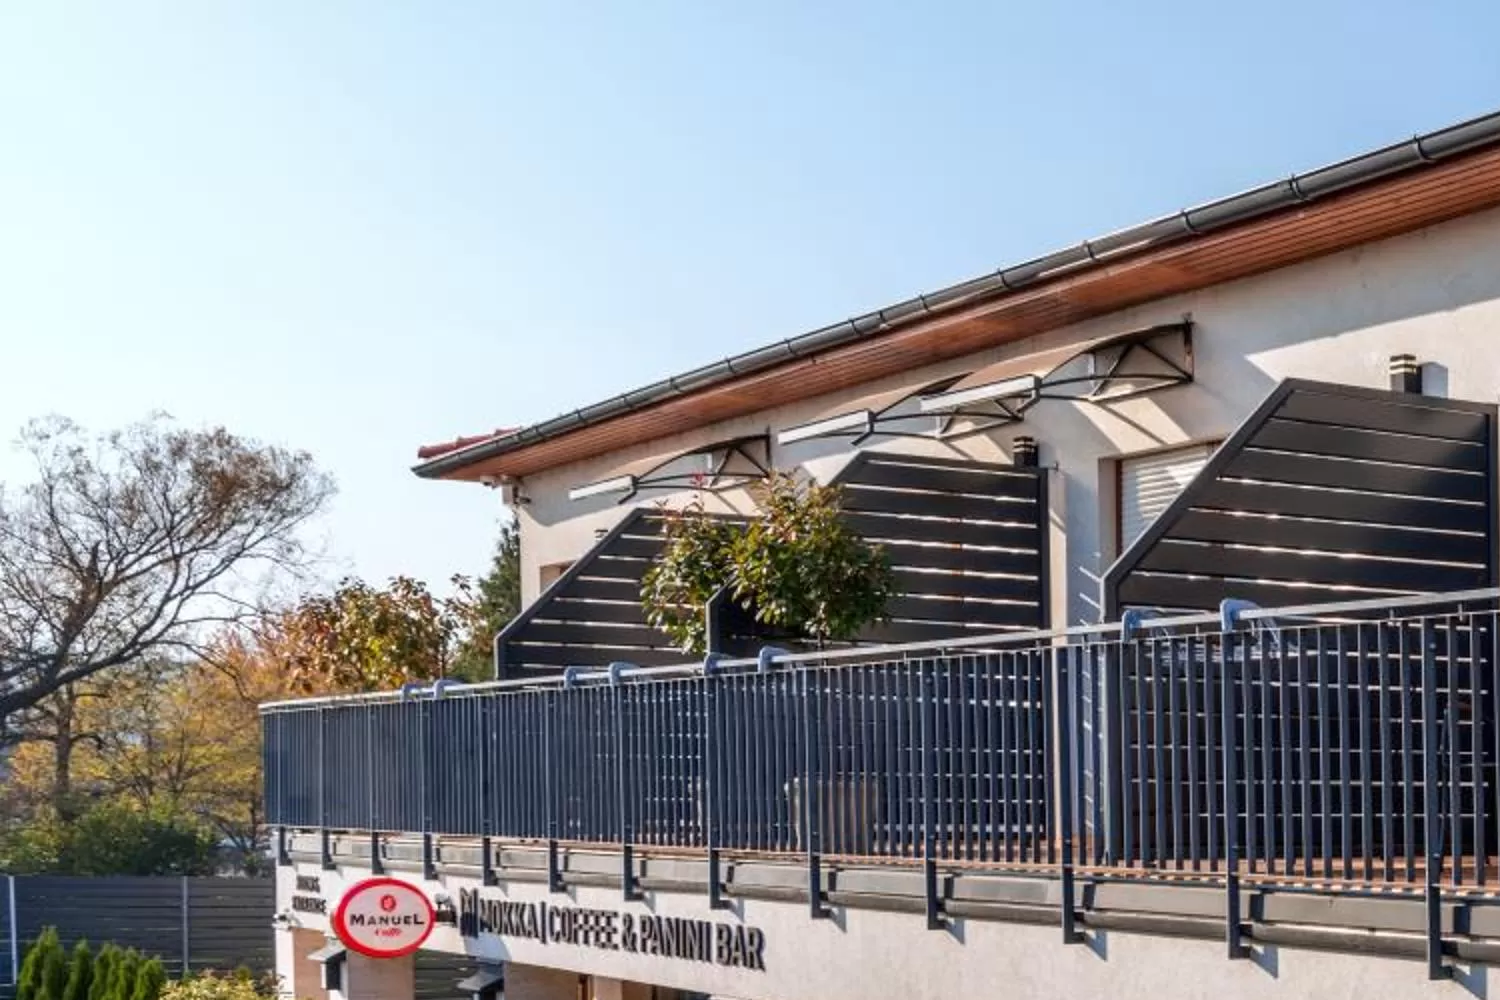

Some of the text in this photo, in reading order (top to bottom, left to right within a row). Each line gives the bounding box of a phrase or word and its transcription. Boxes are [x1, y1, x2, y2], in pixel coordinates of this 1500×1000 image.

[351, 913, 425, 925] MANUEL
[549, 907, 619, 950] COFFEE
[622, 913, 637, 952] &
[640, 915, 712, 963] PANINI
[716, 923, 766, 971] BAR
